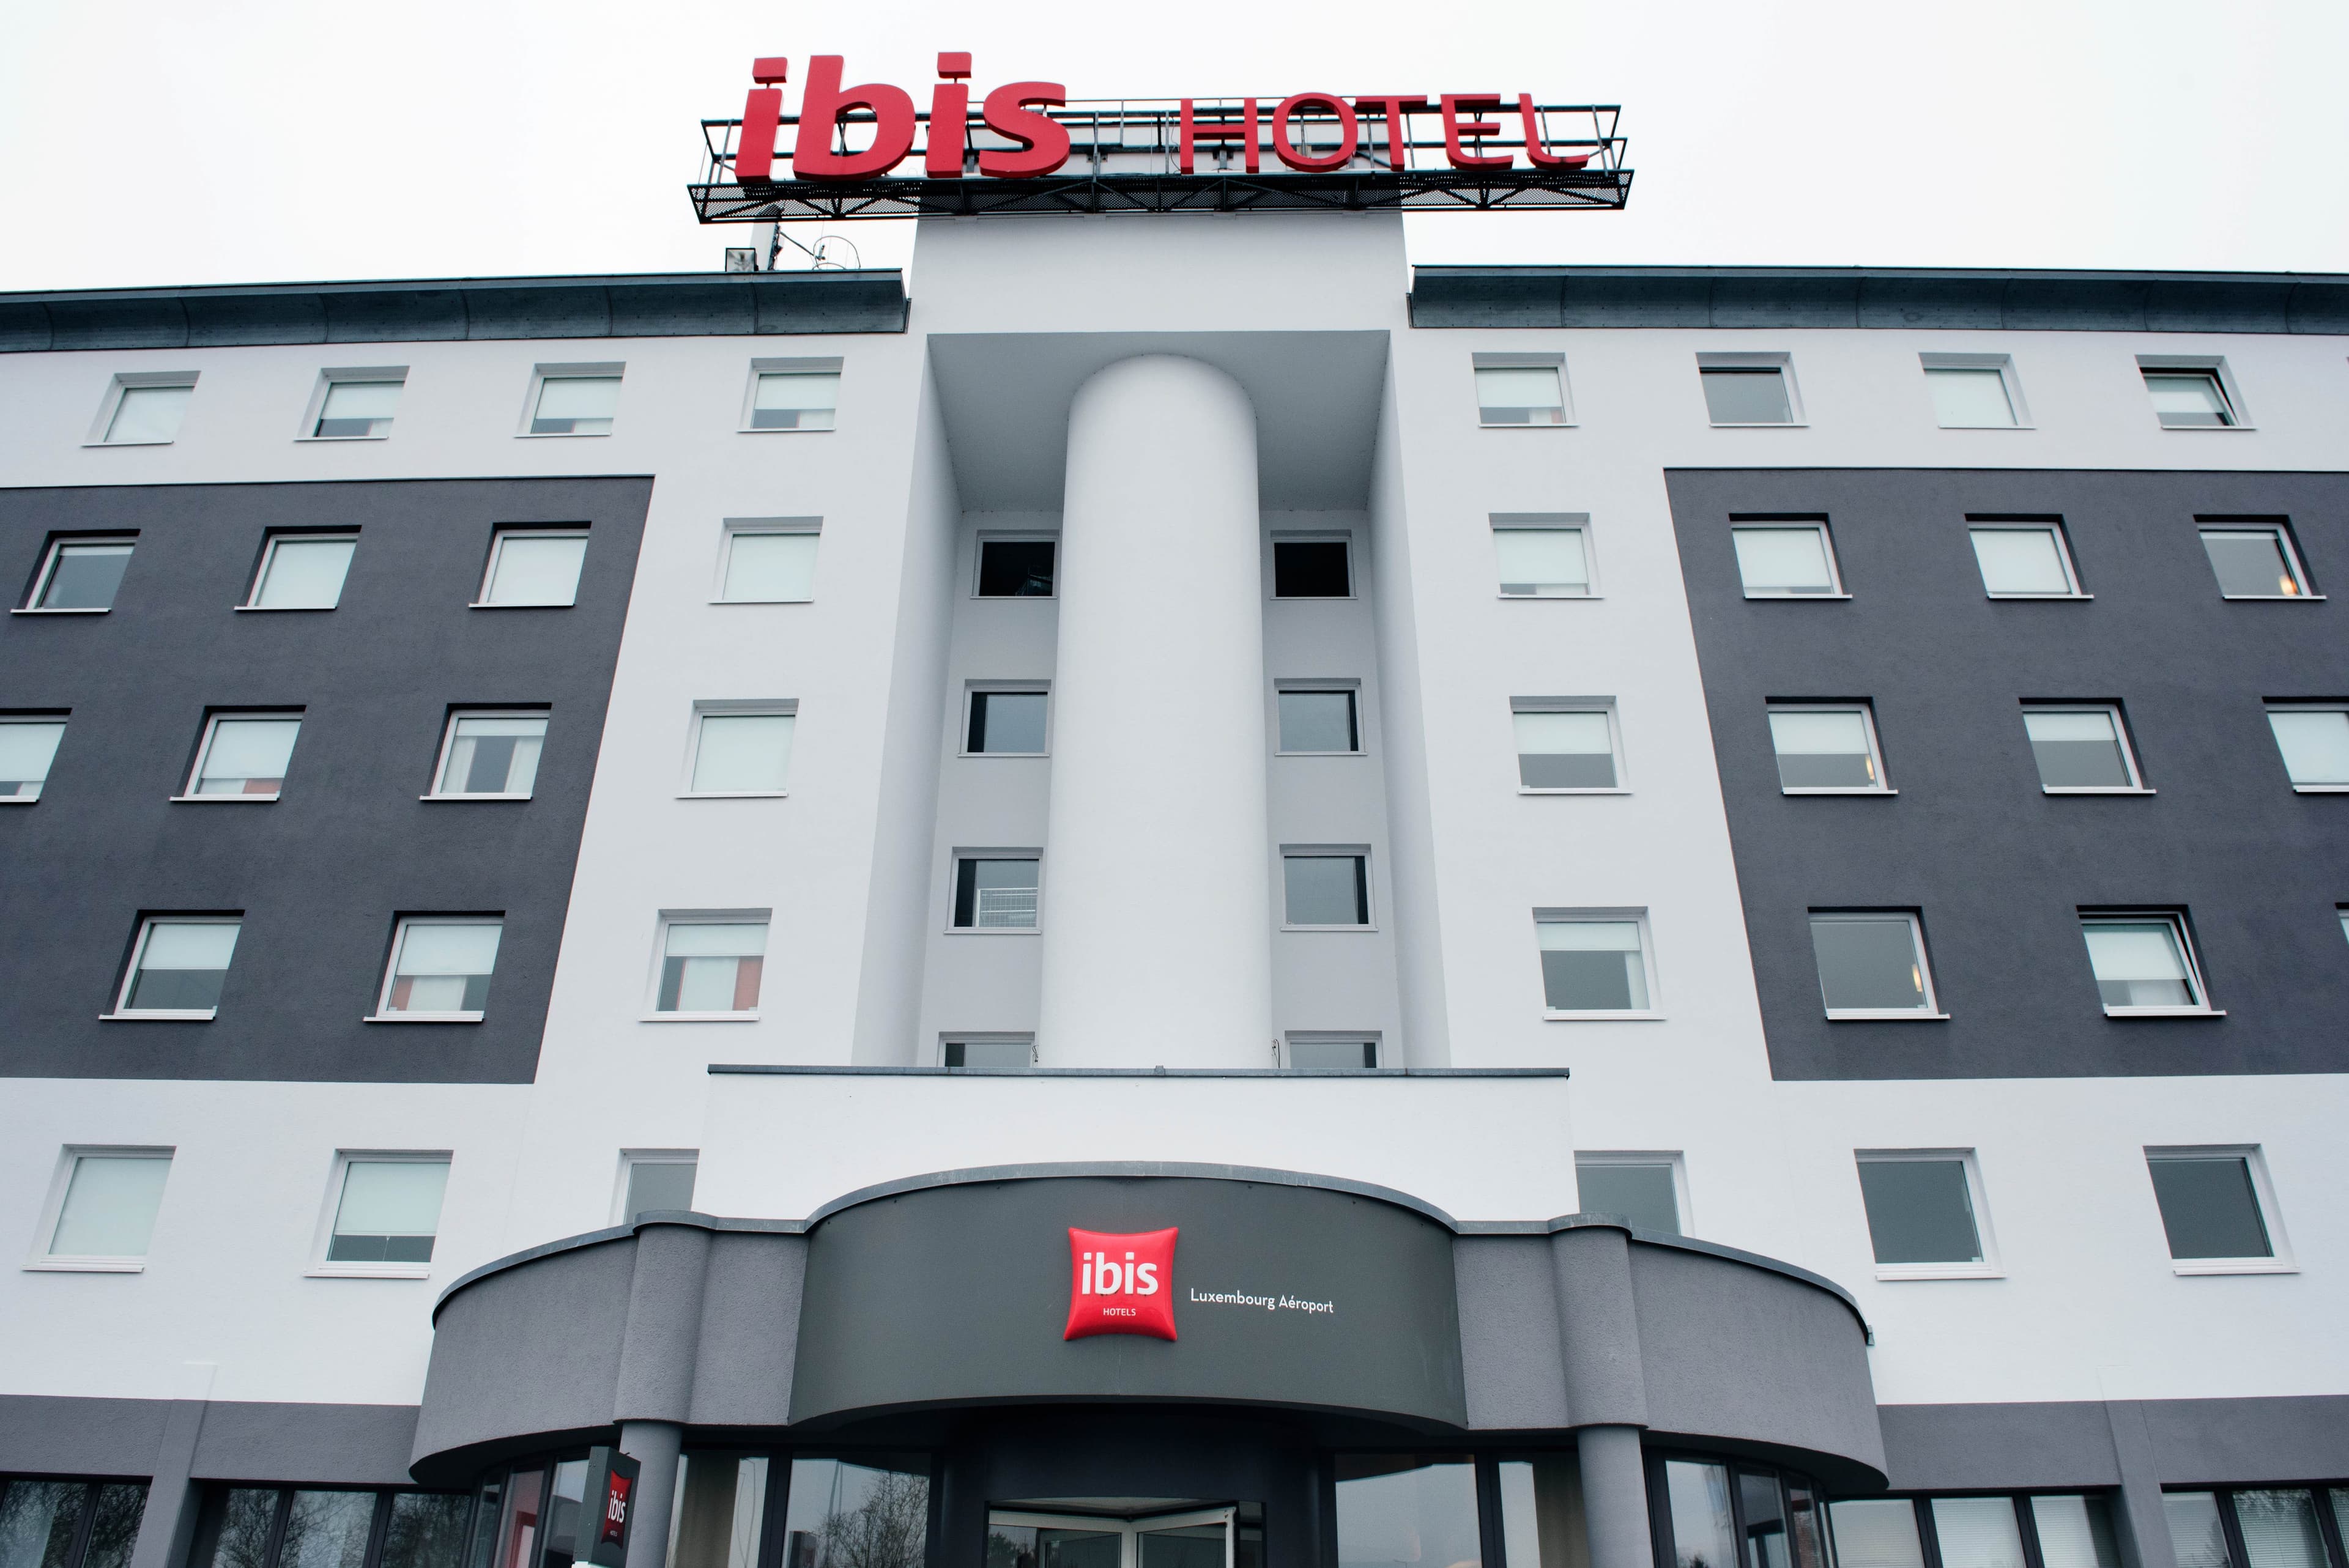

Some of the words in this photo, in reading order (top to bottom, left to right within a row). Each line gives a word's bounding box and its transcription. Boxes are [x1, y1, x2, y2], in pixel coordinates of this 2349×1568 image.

[734, 51, 1071, 180] ibis
[1179, 92, 1590, 175] HOTEL
[1082, 1252, 1159, 1295] ibis
[1103, 1308, 1136, 1317] HOTELS
[1190, 1288, 1275, 1311] Luxembourg
[1278, 1295, 1334, 1314] Aéroport
[608, 1490, 626, 1523] ibis
